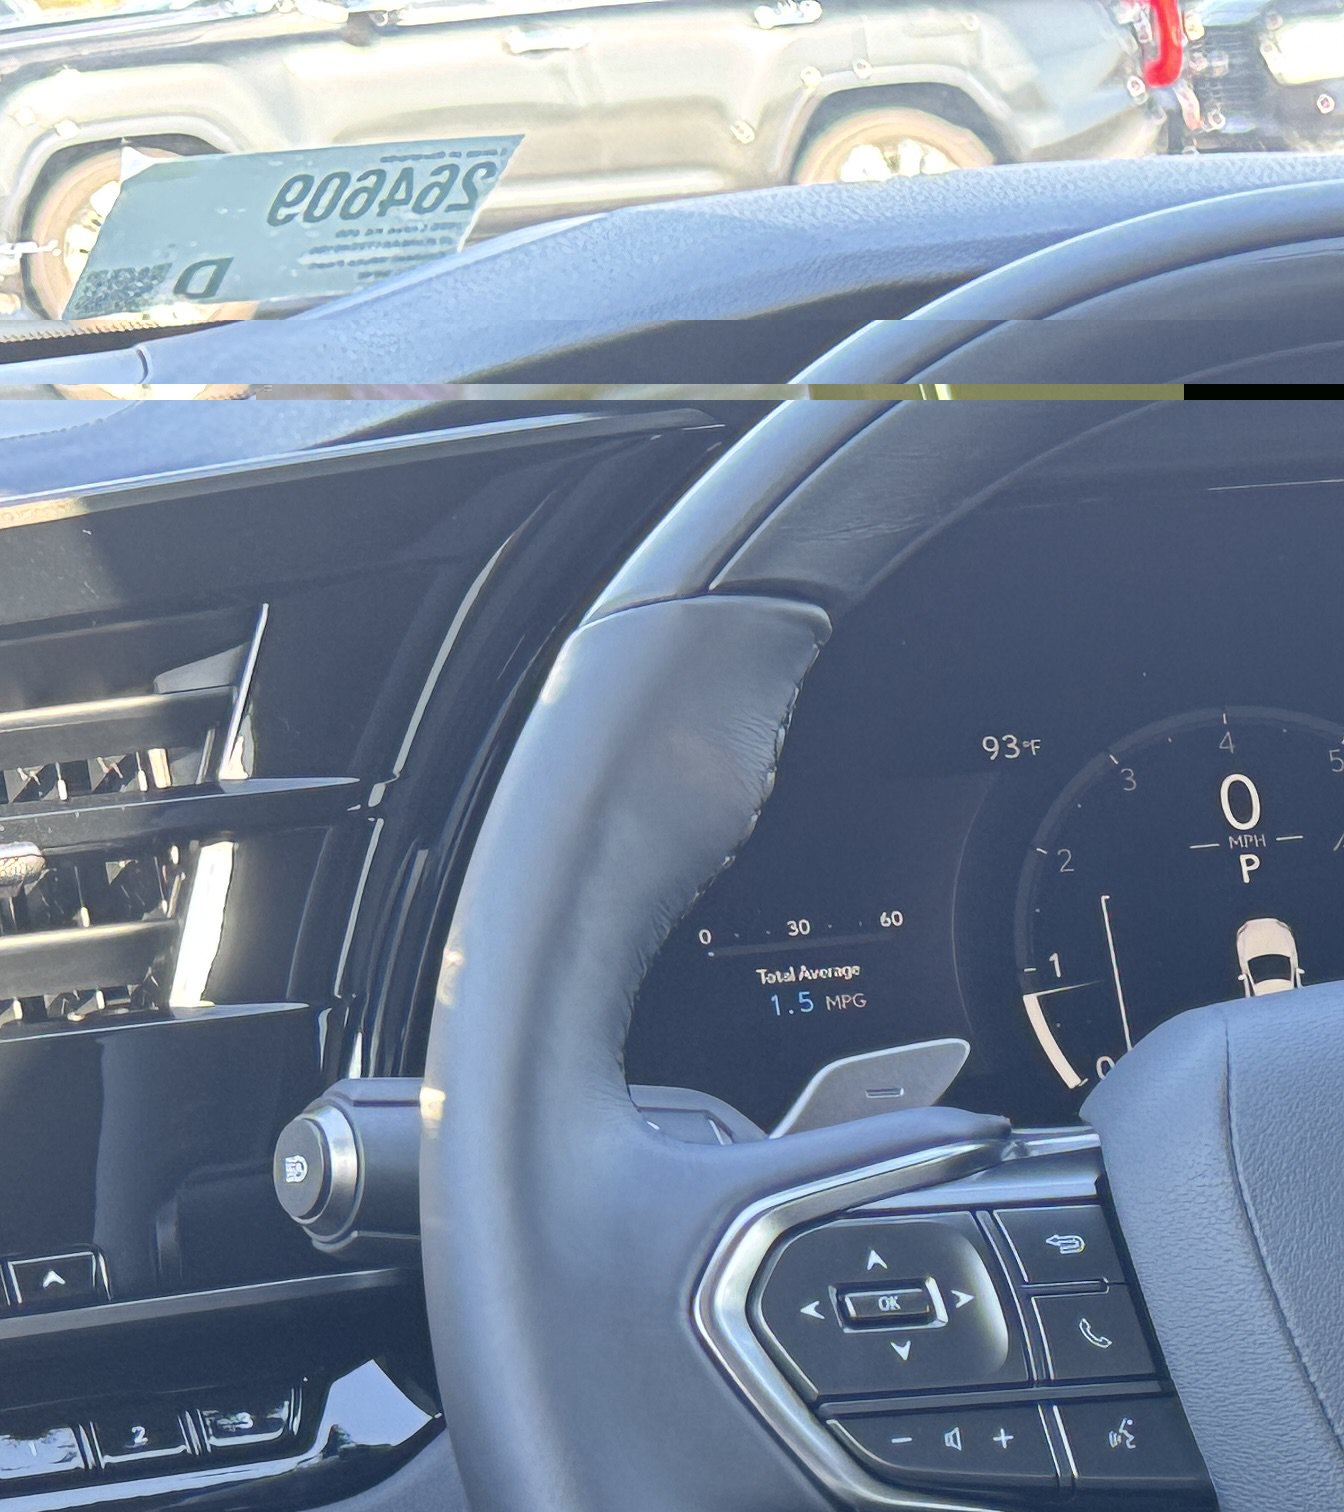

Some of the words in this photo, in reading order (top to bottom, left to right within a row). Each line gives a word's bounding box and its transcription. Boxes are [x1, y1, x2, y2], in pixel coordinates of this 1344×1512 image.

[1218, 731, 1236, 754] 4
[1121, 767, 1138, 792] 3
[1219, 773, 1261, 831] 0
[1228, 832, 1267, 850] MPH
[1058, 848, 1075, 874] 2
[1240, 853, 1261, 884] P
[699, 928, 712, 946] 0
[786, 918, 811, 937] 30
[879, 909, 904, 929] 60
[755, 966, 796, 986] Total
[799, 963, 861, 983] Average
[1048, 952, 1063, 978] 1
[770, 991, 815, 1017] 1.5
[825, 991, 868, 1013] MPG
[878, 1295, 901, 1313] OK
[131, 1425, 148, 1444] 2
